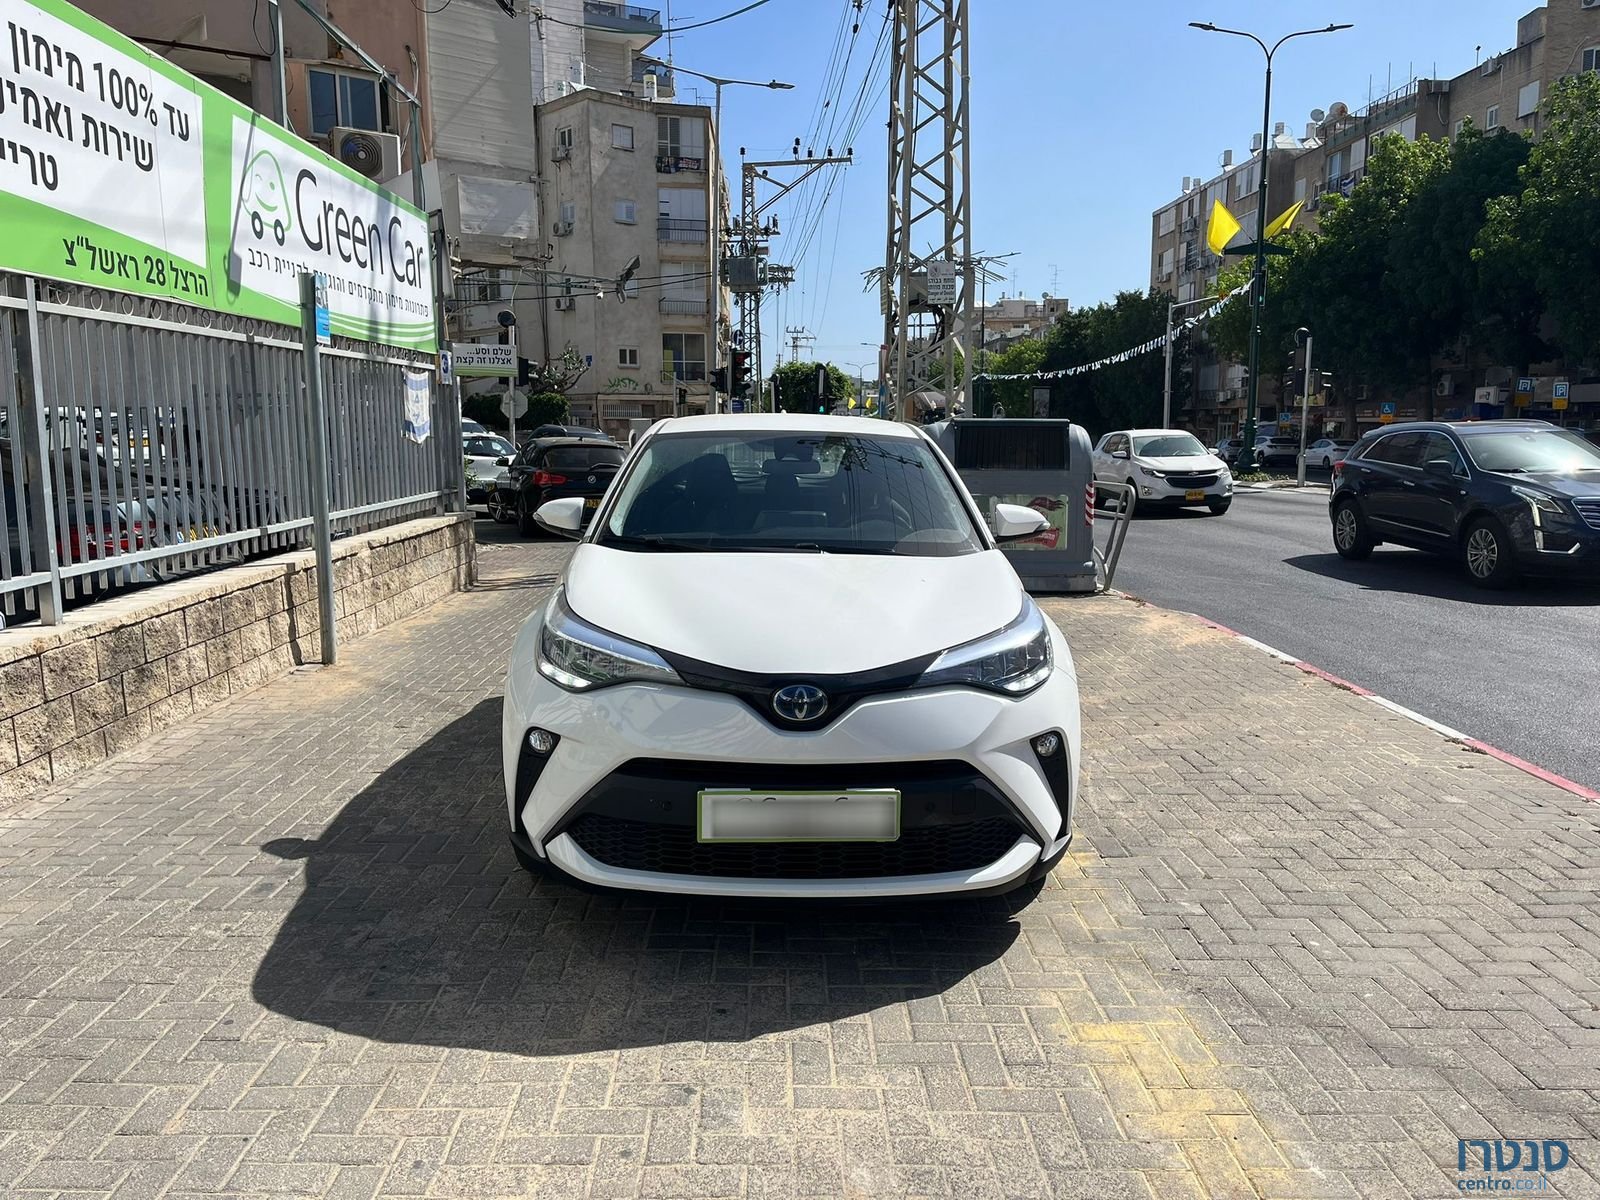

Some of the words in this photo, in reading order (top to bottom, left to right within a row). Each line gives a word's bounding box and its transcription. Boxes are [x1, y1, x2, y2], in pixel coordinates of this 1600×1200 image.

[7, 20, 85, 92] מימון
[93, 62, 158, 127] 100%
[163, 102, 190, 142] עד
[81, 113, 154, 172] שירות
[296, 168, 384, 275] Green
[388, 216, 424, 289] Car
[248, 247, 271, 270] רכב
[144, 255, 167, 287] 28
[169, 261, 209, 297] הרצל
[348, 281, 384, 304] מתקדמים
[385, 292, 404, 310] מימון
[405, 299, 429, 317] פתרונות
[455, 356, 474, 365] קצת
[476, 356, 486, 364] זה
[488, 356, 512, 365] אצלנו
[492, 347, 512, 356] שלם
